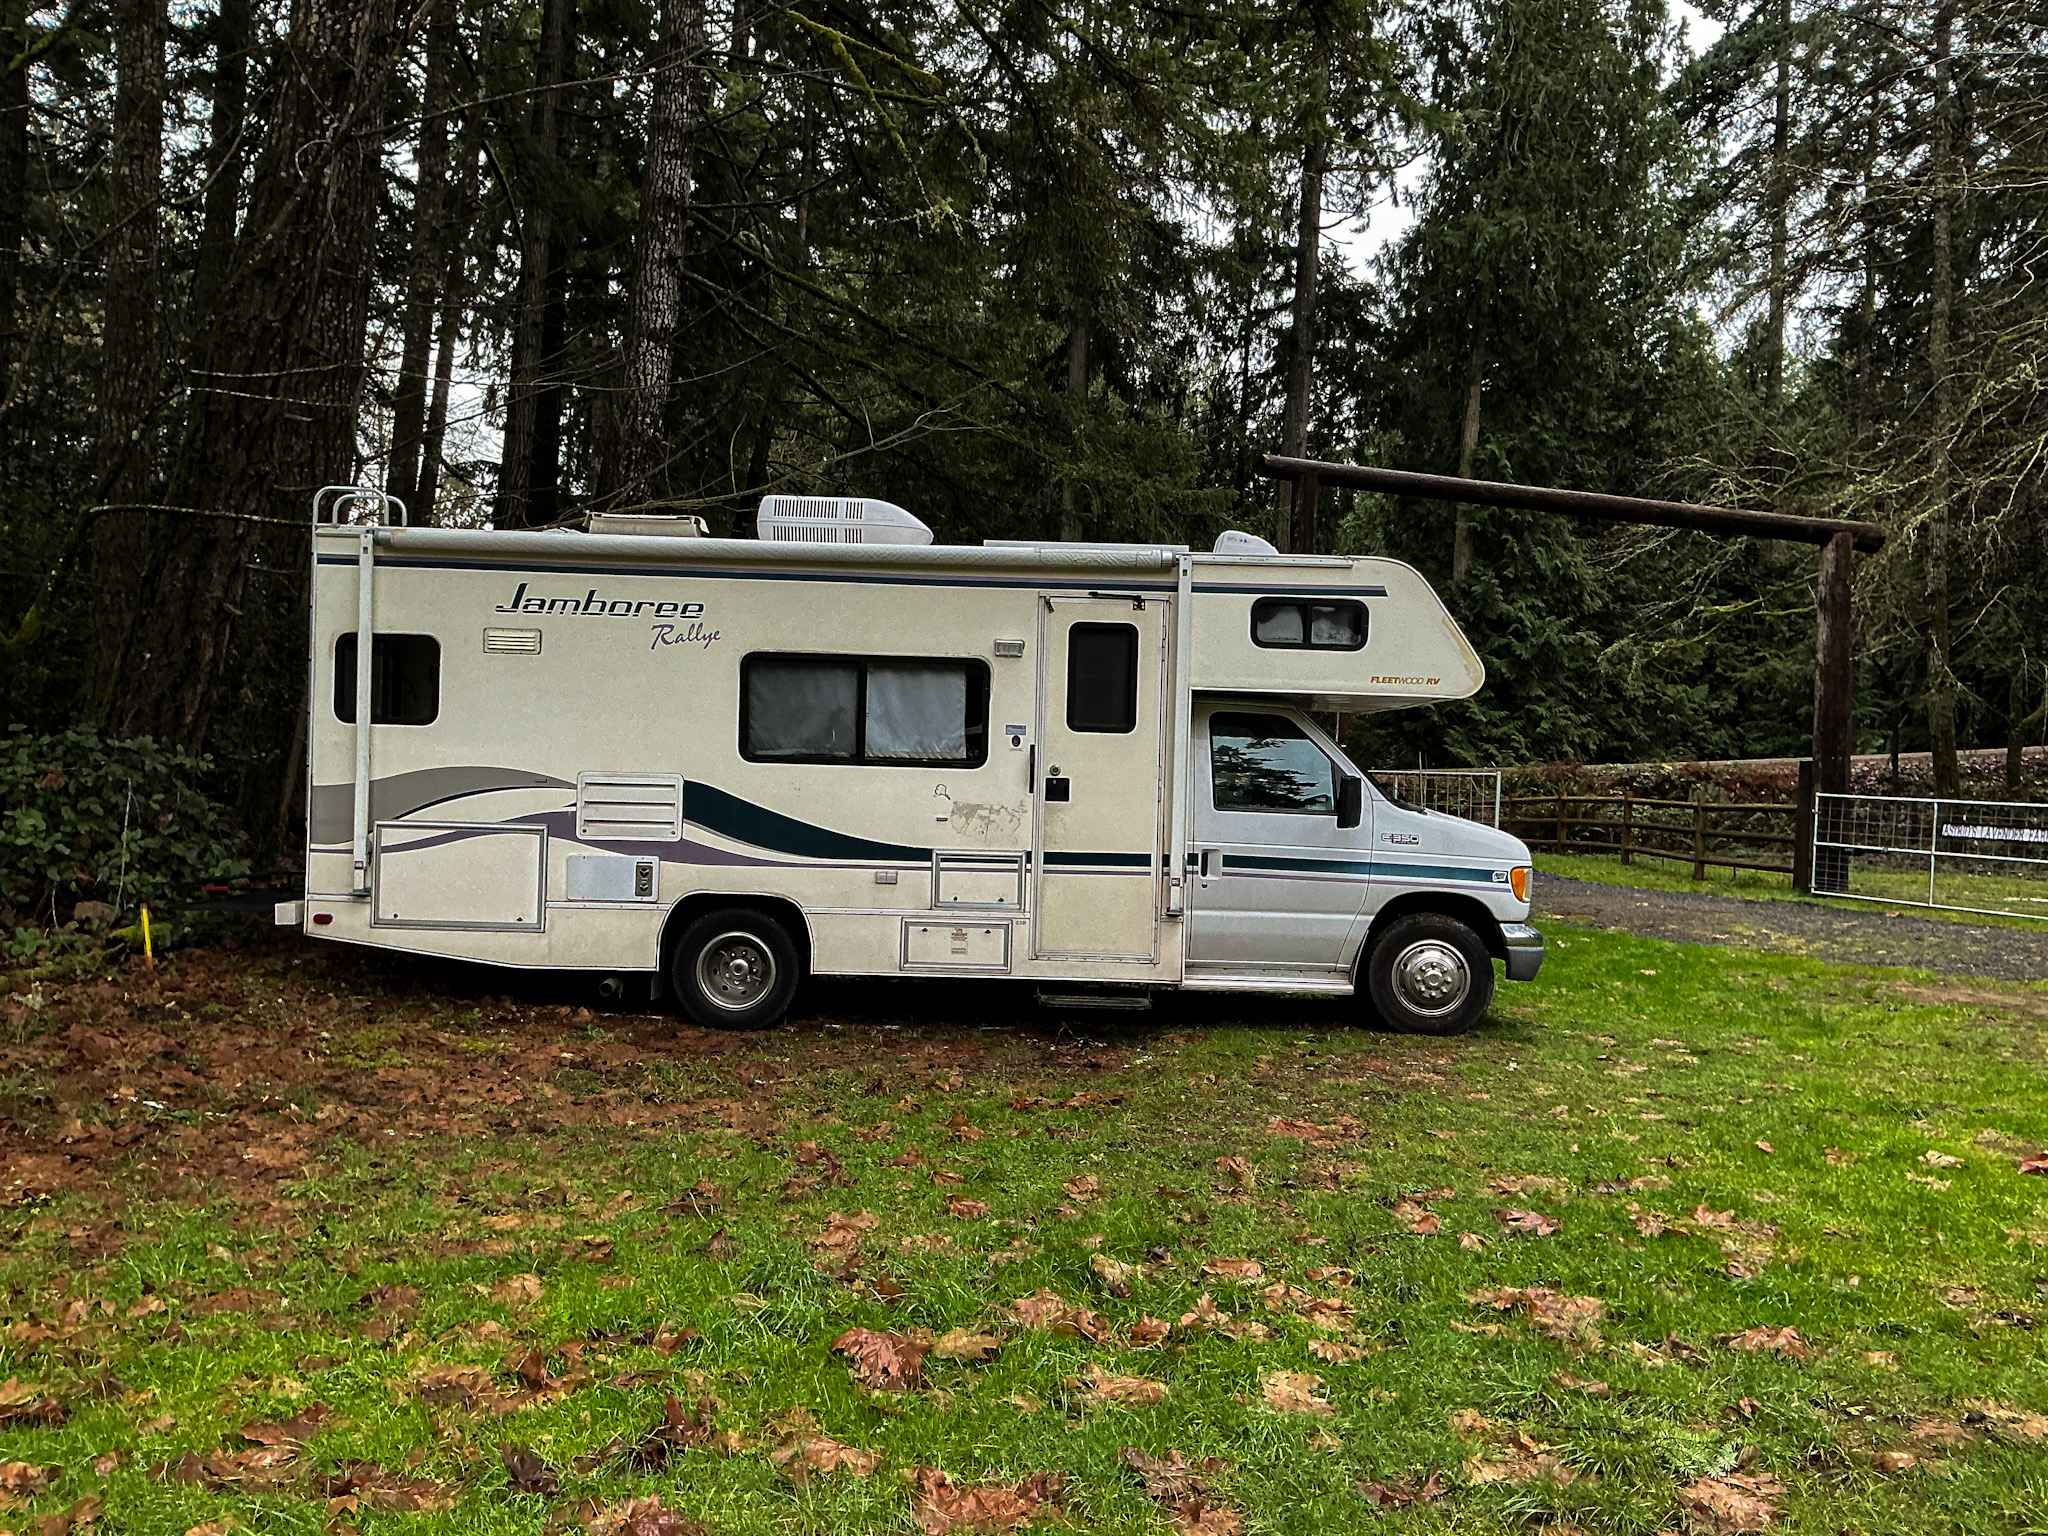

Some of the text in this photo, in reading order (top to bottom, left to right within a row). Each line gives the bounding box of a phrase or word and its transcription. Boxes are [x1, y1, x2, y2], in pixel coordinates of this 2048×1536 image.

[495, 582, 705, 619] Jamboree
[651, 622, 721, 650] Rallye
[1370, 676, 1441, 686] FLEETWOOD RV
